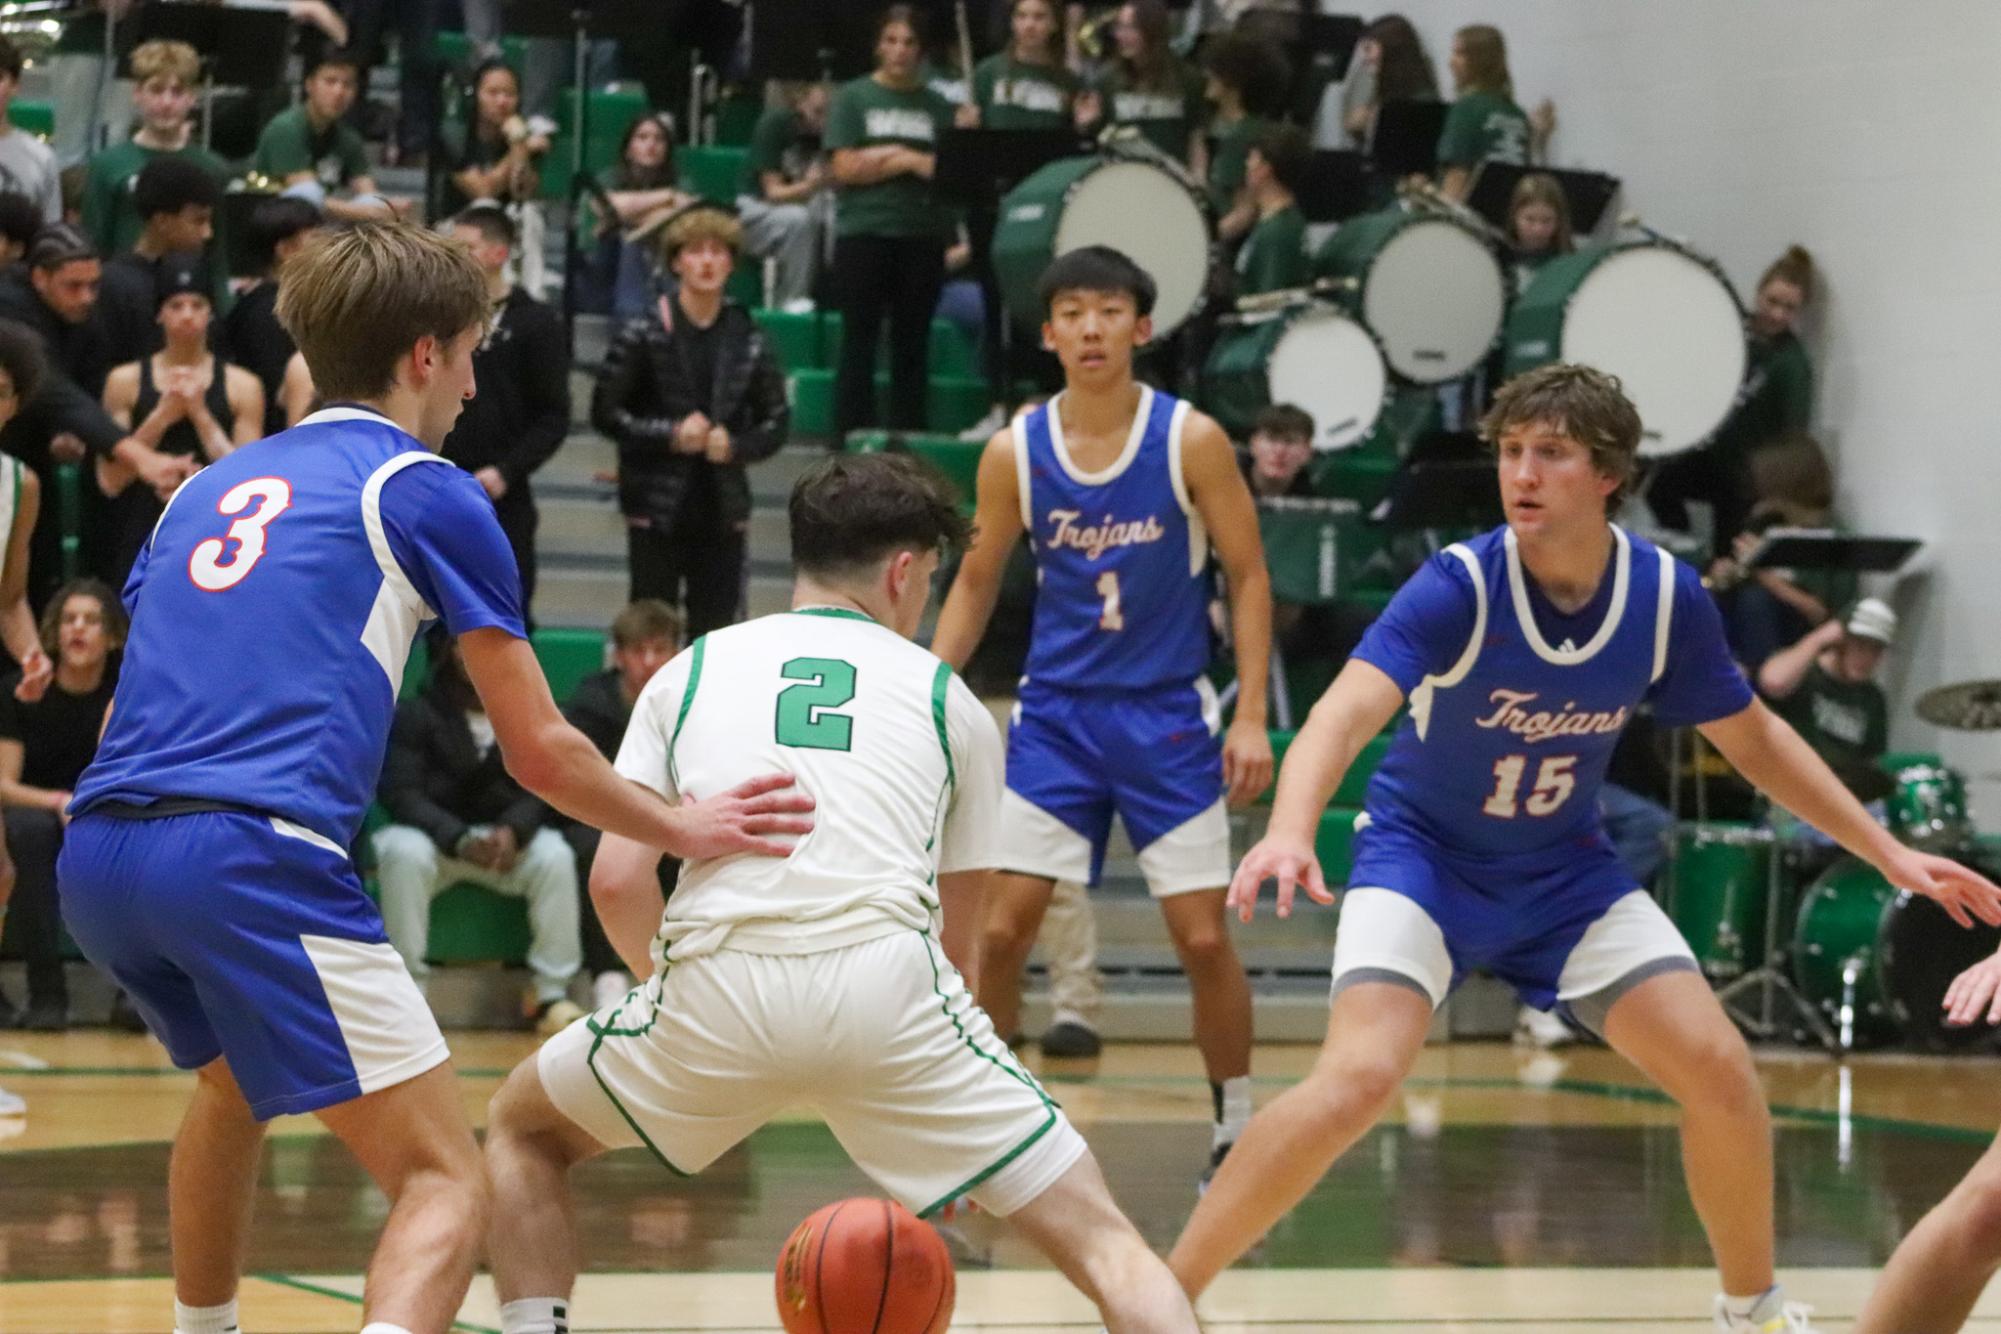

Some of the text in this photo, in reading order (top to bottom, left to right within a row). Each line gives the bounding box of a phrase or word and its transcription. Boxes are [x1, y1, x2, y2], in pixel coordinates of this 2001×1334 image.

[187, 476, 294, 592] 3
[1047, 508, 1164, 561] Trojans
[1096, 570, 1123, 631] 1
[775, 656, 857, 752] 2
[1483, 754, 1577, 818] 15
